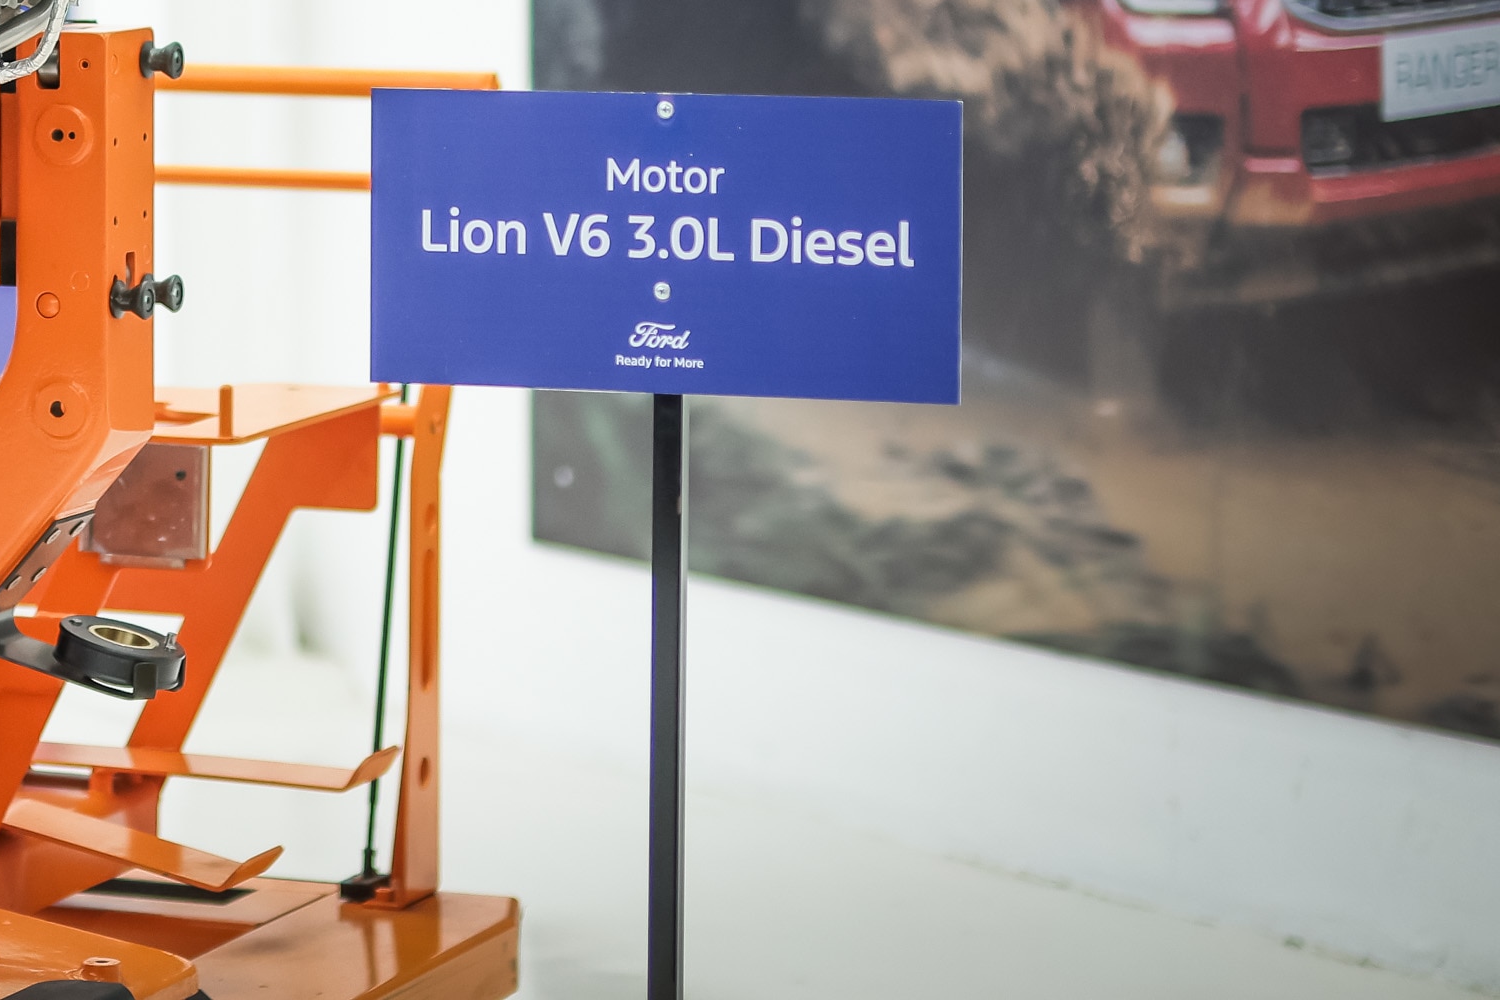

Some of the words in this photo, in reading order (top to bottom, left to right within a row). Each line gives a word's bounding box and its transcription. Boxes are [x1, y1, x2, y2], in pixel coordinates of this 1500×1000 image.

[1395, 41, 1499, 94] RANGER
[606, 157, 725, 194] Motor
[421, 206, 527, 255] Lion
[542, 212, 611, 258] V6
[627, 214, 735, 262] 3.0L
[750, 215, 915, 268] Diesel
[628, 321, 691, 350] Ford
[615, 354, 653, 369] Ready
[654, 355, 673, 368] for
[673, 357, 705, 369] More
